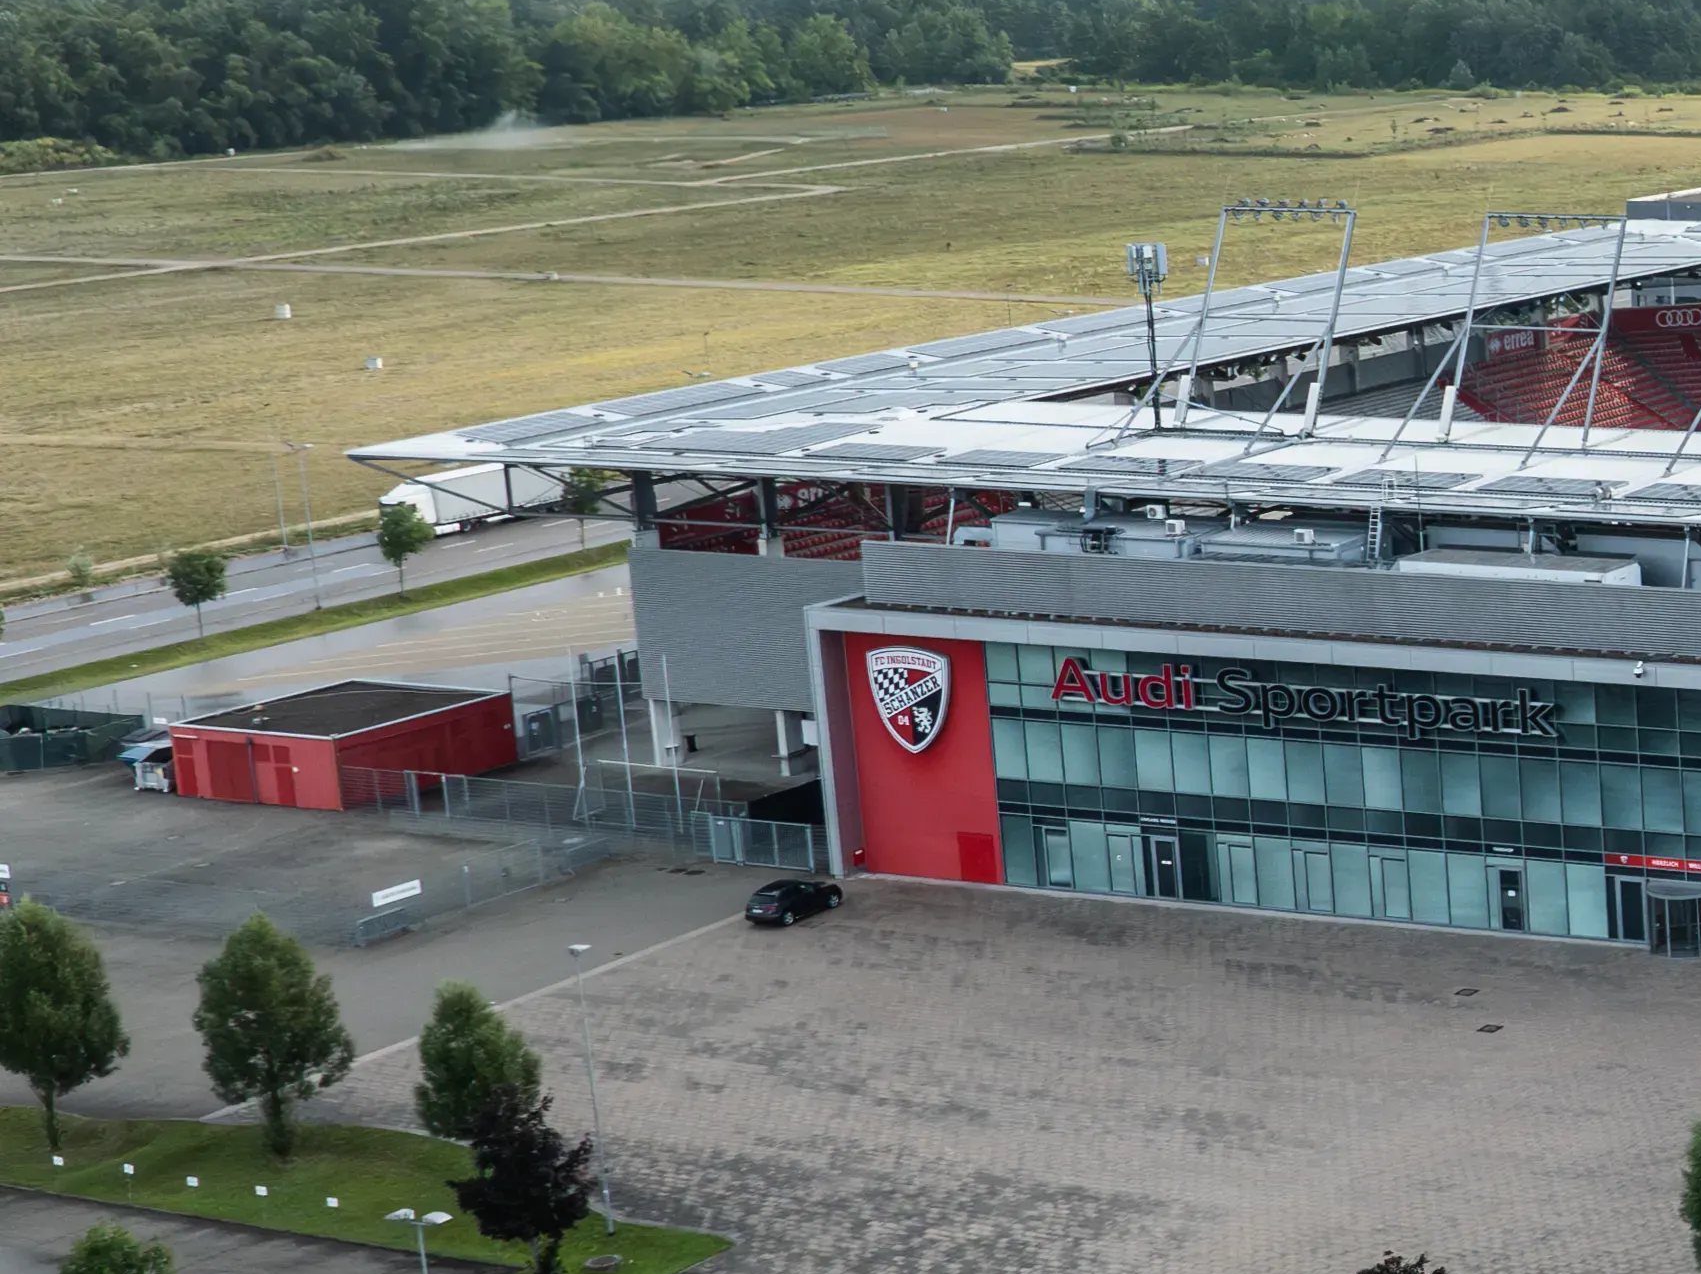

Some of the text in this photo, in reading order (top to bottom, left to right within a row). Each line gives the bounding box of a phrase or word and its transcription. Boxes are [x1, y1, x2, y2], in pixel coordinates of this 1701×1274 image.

[874, 655, 937, 670] FC INGOLSTADT
[883, 676, 941, 715] SCHANZER
[1051, 657, 1559, 741] Audi Sportpark
[897, 715, 910, 726] 04
